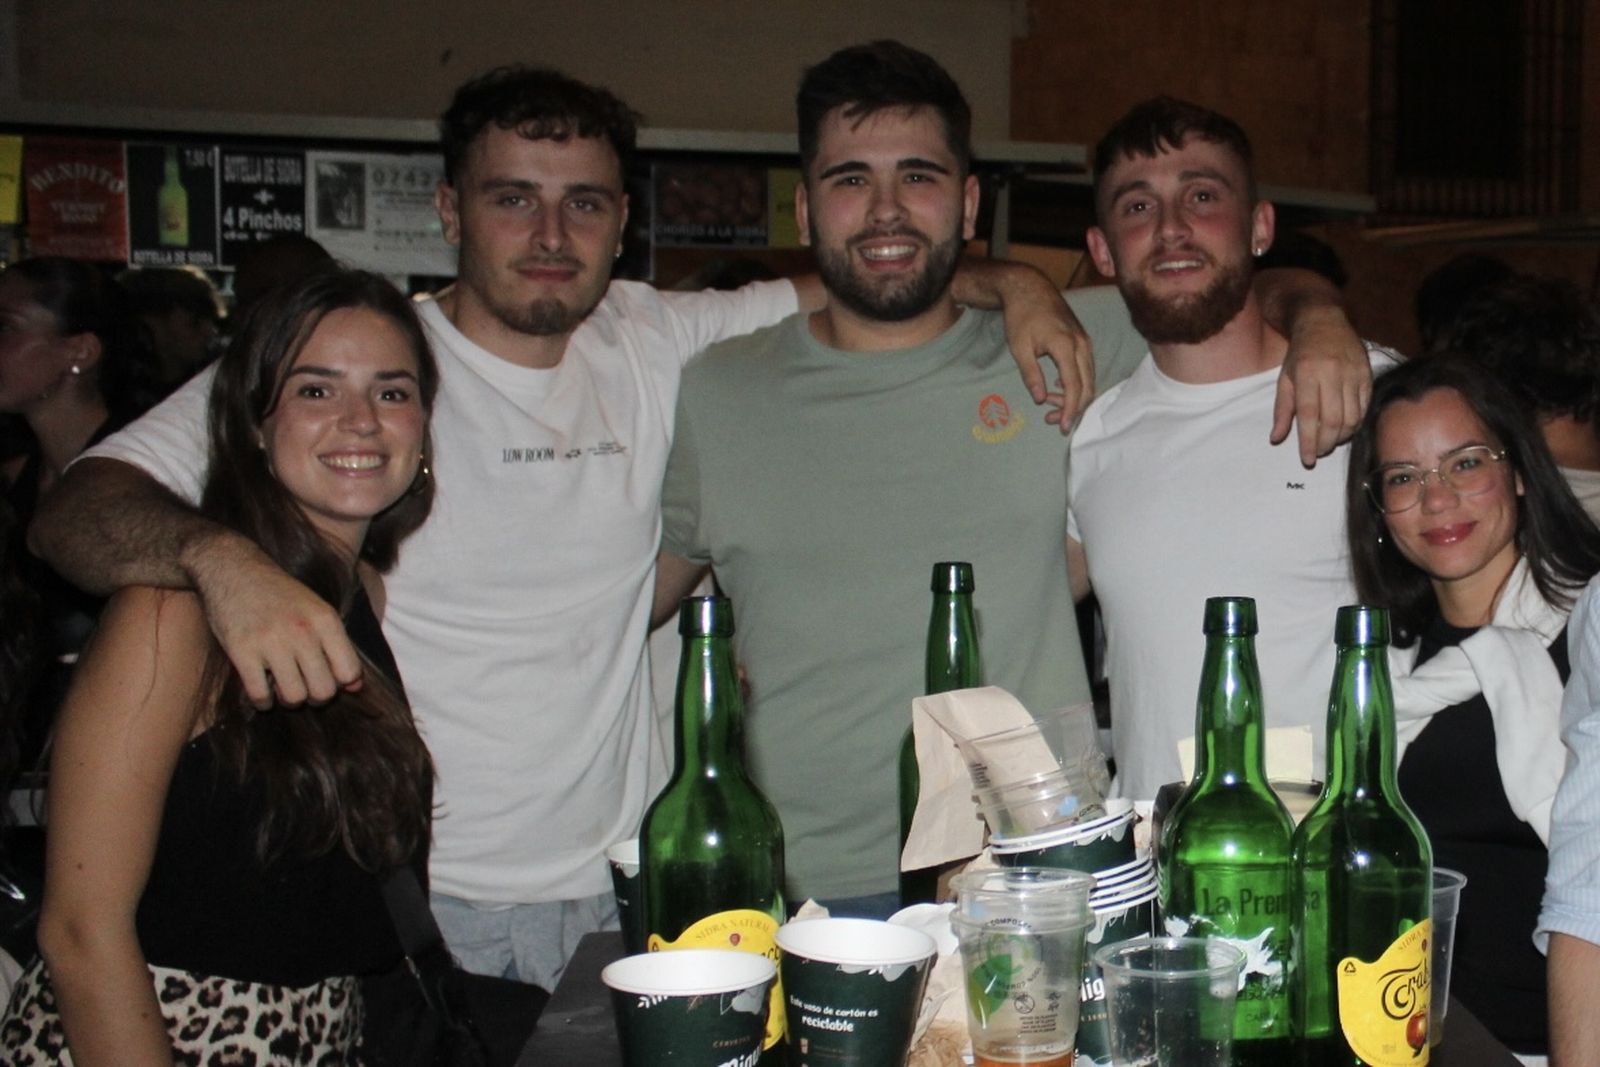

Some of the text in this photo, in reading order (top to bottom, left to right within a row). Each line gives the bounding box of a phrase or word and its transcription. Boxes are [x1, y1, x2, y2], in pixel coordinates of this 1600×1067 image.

[31, 161, 125, 194] BENDITO
[223, 206, 303, 232] 4 Pinchos
[503, 447, 522, 463] LOW
[525, 447, 555, 463] ROOM
[1201, 887, 1320, 916] La Prena
[695, 922, 729, 940] SIDRA
[803, 1003, 822, 1014] vaso
[823, 1006, 834, 1015] de
[835, 1008, 867, 1018] cartón
[867, 1009, 879, 1018] es
[801, 1015, 855, 1033] reciclable
